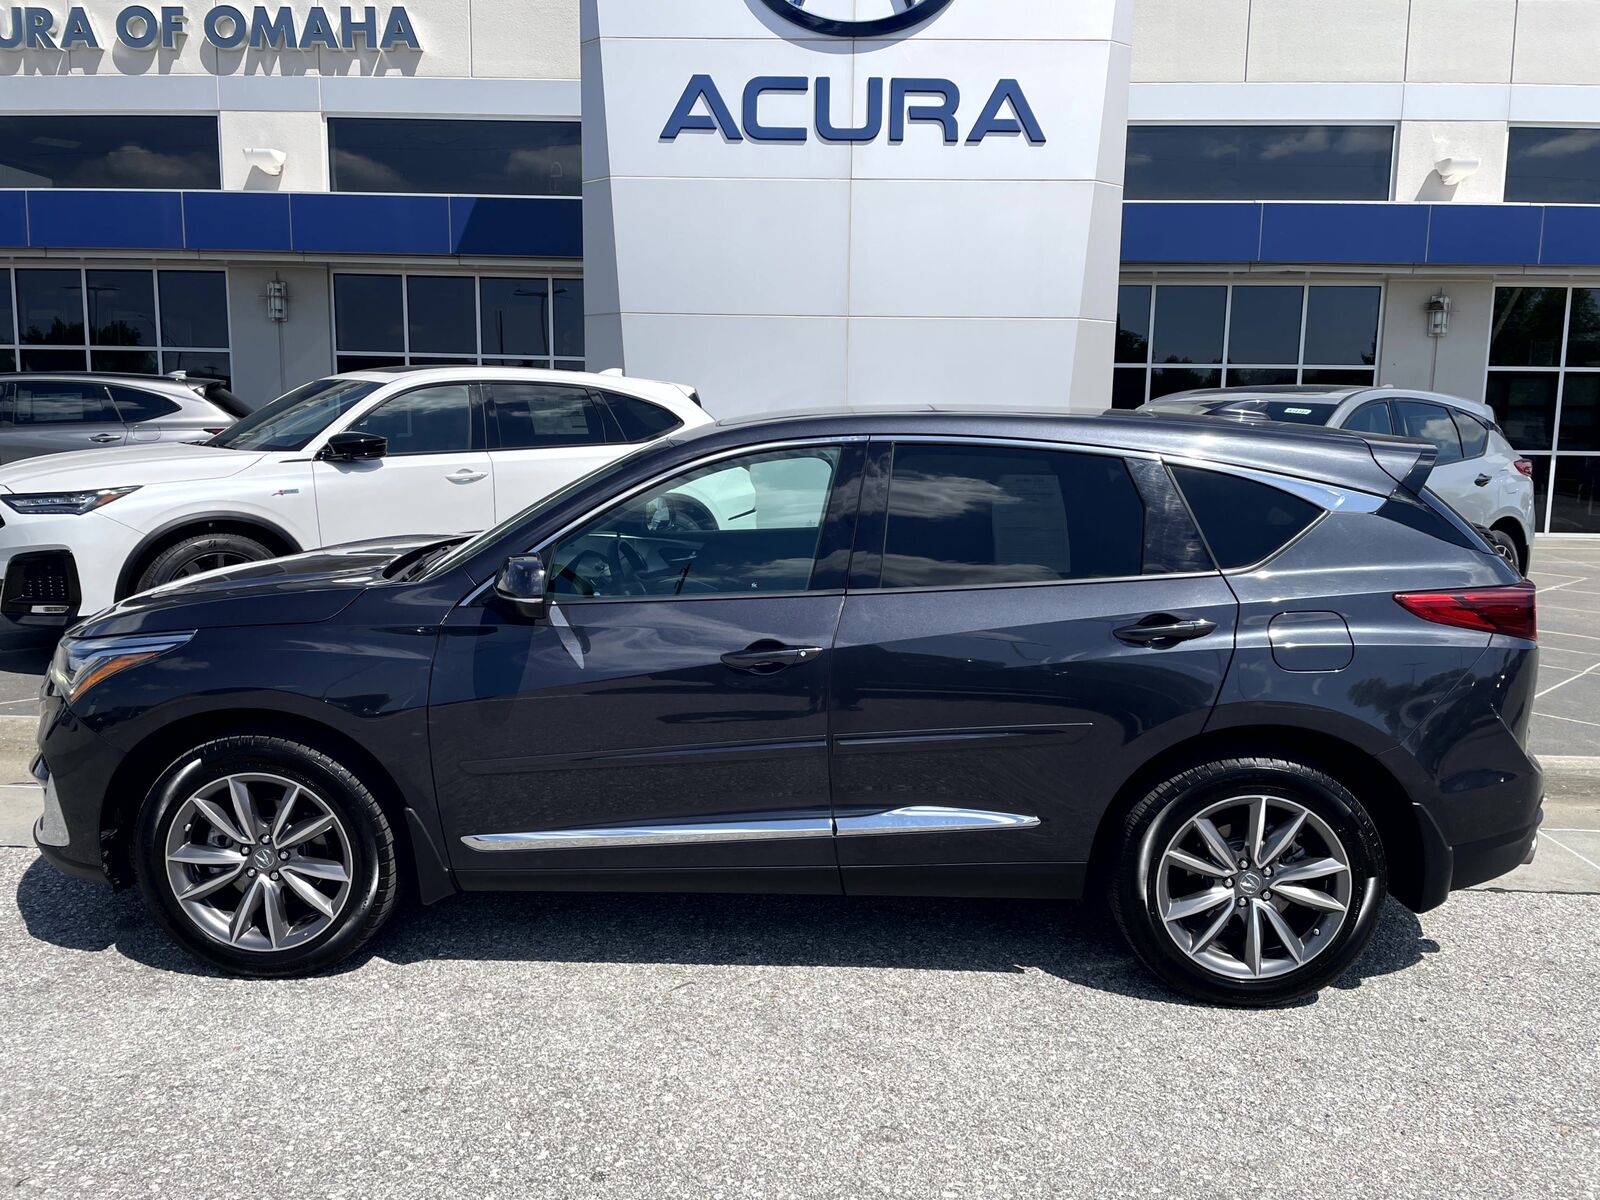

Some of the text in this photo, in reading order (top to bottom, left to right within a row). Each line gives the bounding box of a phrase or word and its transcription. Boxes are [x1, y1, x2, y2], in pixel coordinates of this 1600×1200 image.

[115, 5, 186, 49] OF
[203, 5, 421, 51] OMAHA
[658, 74, 1047, 143] ACURA
